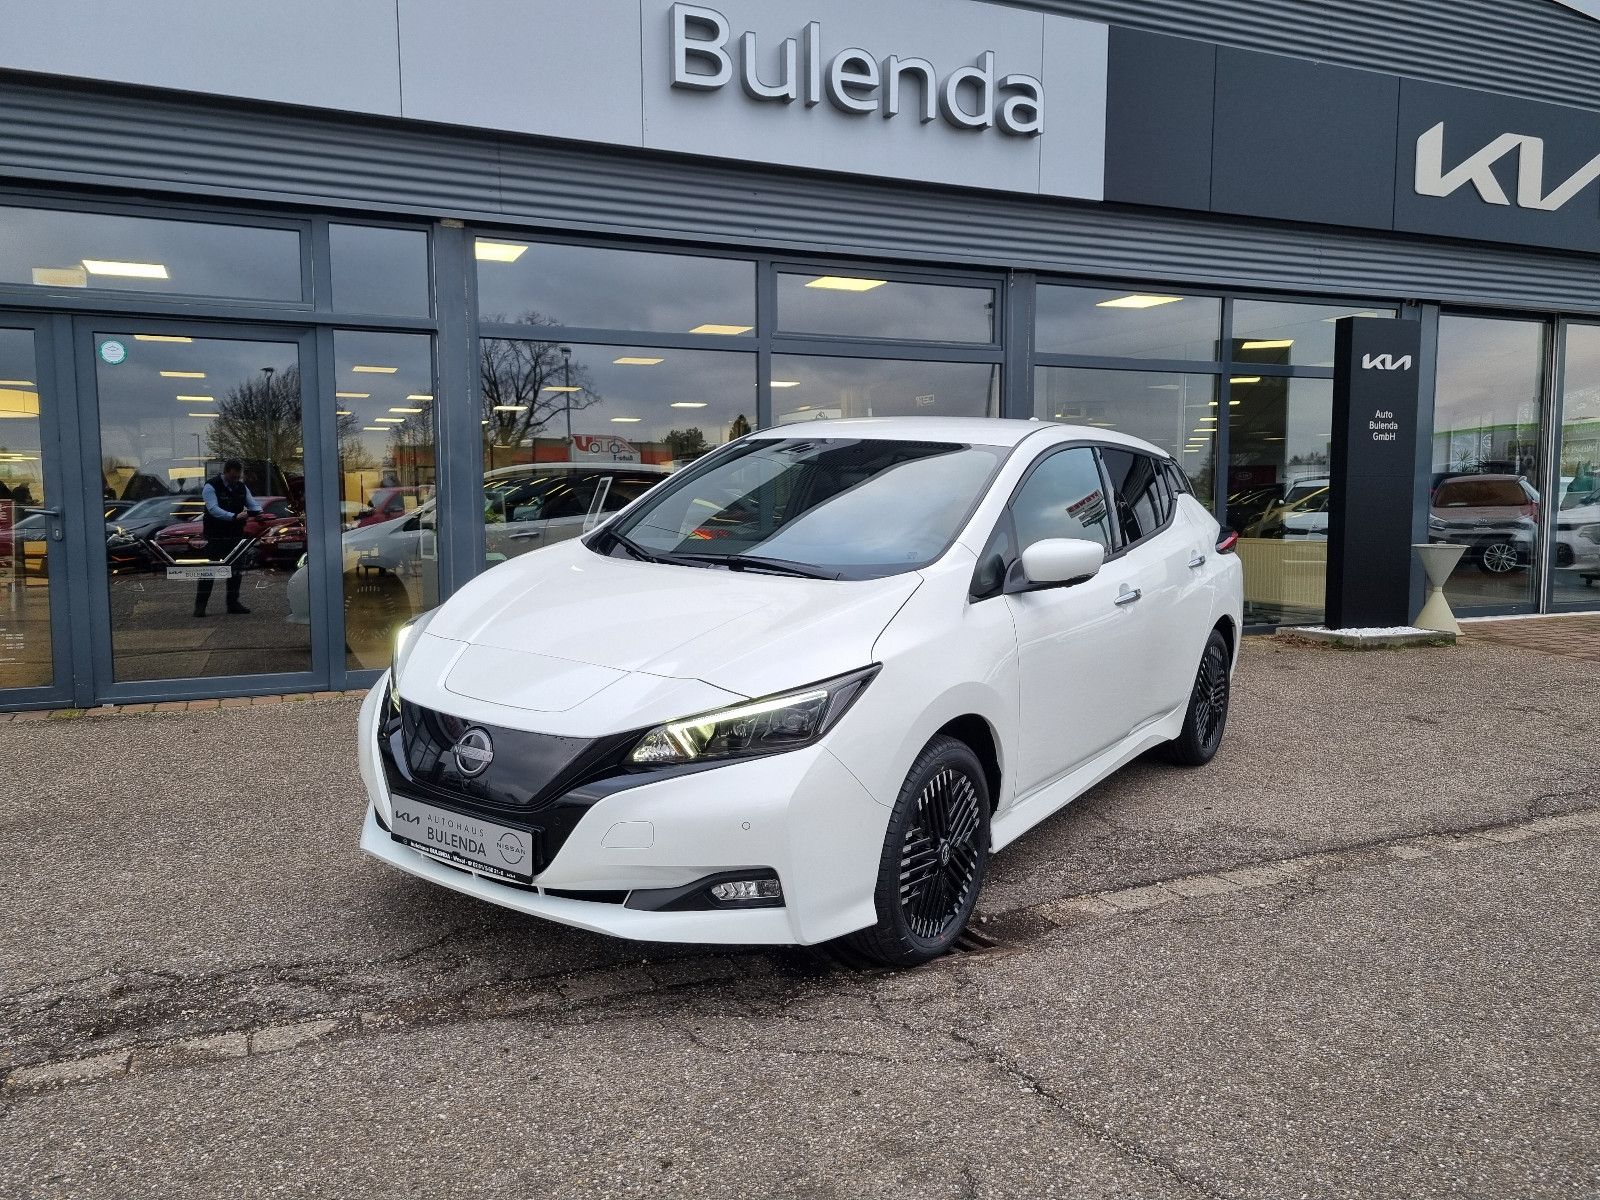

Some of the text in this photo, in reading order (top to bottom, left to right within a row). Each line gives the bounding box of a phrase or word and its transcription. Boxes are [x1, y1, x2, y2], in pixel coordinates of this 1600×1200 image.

[669, 2, 1045, 138] Bulenda
[1362, 353, 1412, 371] KIA
[1375, 409, 1393, 419] Auto
[1369, 421, 1398, 430] Bulenda
[1372, 432, 1396, 441] GmbH
[395, 810, 420, 826] KIA
[427, 814, 484, 837] AUTOHAUS
[427, 827, 487, 857] BULENDA
[496, 842, 526, 855] NISSAN
